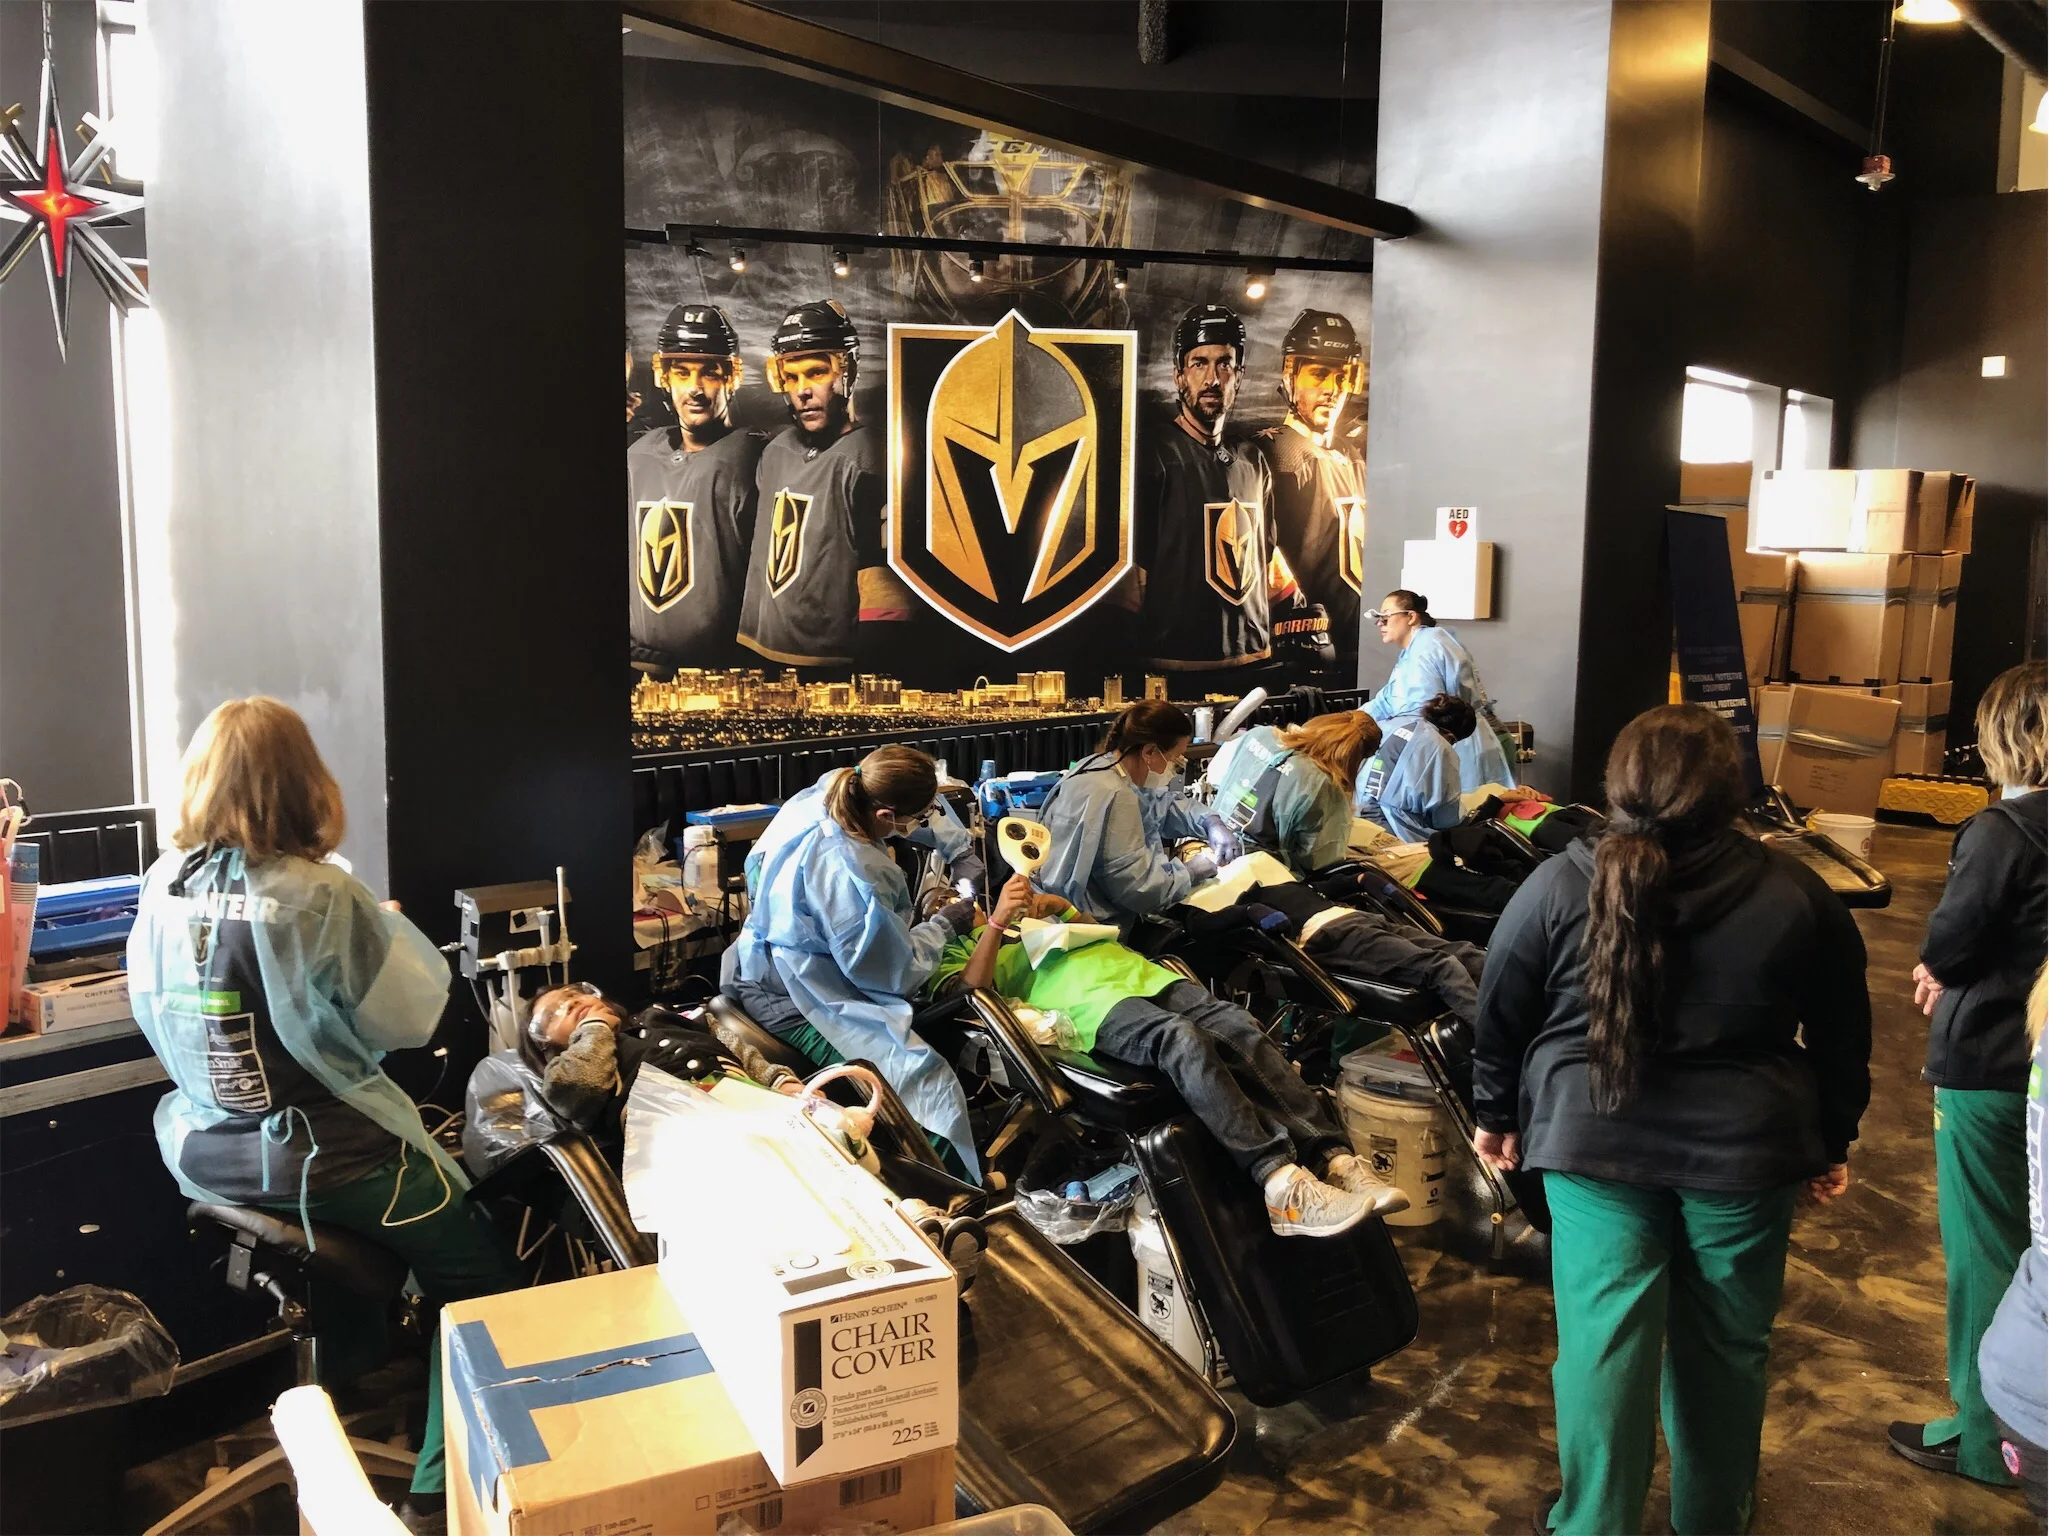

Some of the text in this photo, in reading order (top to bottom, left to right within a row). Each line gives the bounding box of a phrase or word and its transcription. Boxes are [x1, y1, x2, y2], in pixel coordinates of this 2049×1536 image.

[1323, 340, 1350, 349] CCM
[1449, 509, 1469, 519] AED
[1274, 617, 1329, 636] WARRIOR
[839, 1303, 905, 1322] HENRY SCHEIN
[831, 1312, 931, 1352] CHAIR
[831, 1337, 936, 1379] COVER
[856, 1390, 872, 1399] para
[891, 1424, 922, 1446] 225
